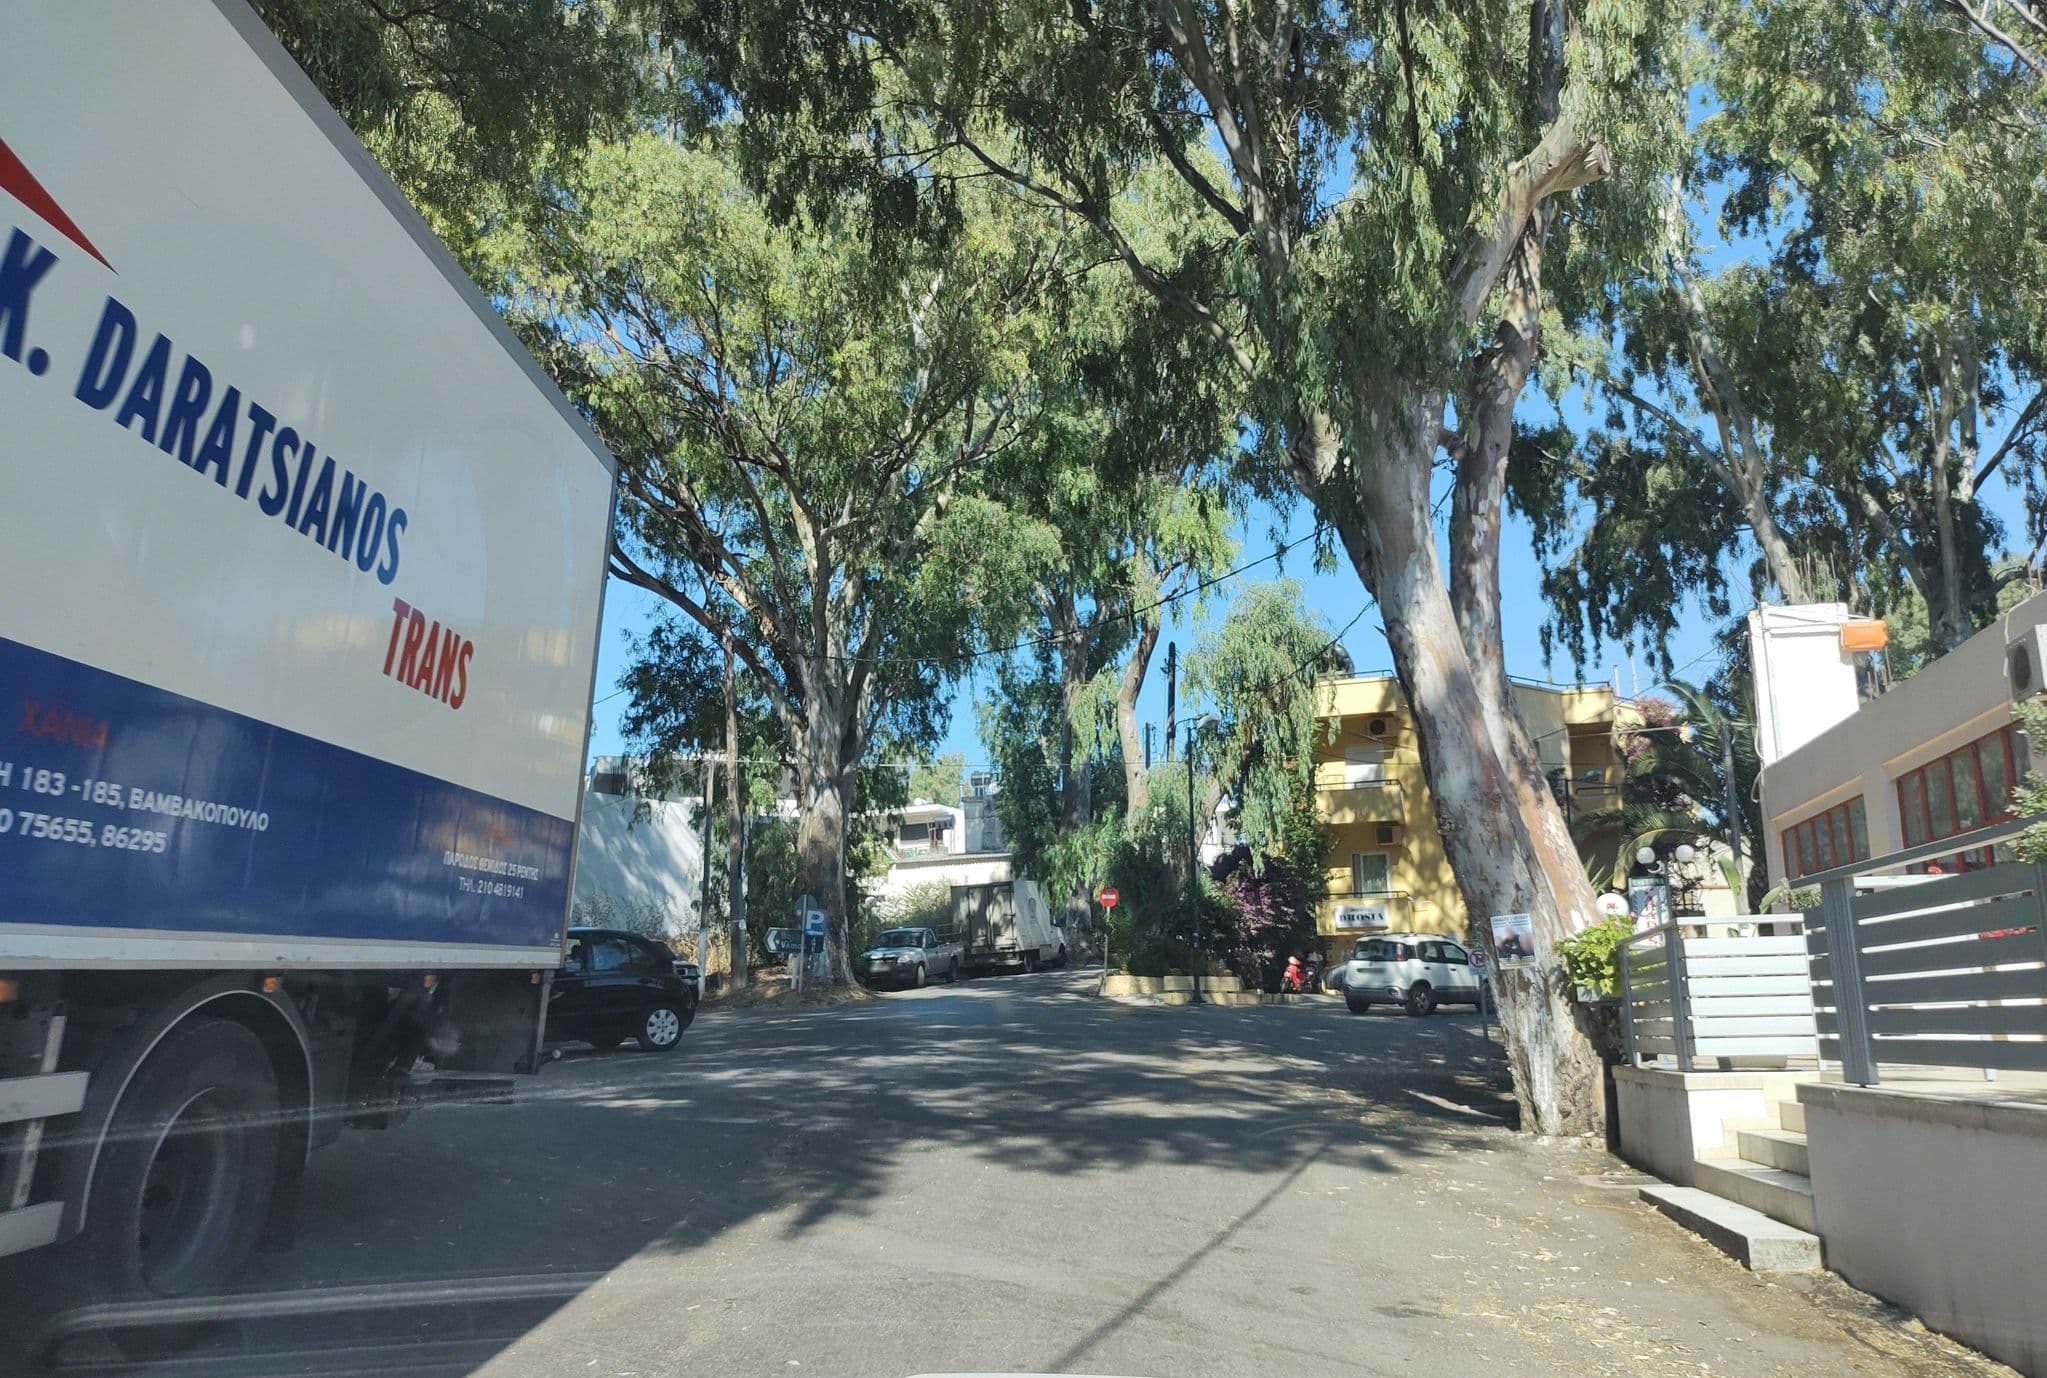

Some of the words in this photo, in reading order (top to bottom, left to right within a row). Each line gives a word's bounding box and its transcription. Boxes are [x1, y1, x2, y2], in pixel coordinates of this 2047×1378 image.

[0, 226, 60, 377] K.
[73, 295, 409, 586] DARATSIANOS
[383, 597, 474, 710] TRANS
[22, 767, 66, 796] 183
[18, 811, 97, 848] 75655,
[101, 825, 168, 854] 86295
[477, 880, 493, 895] 210
[806, 910, 824, 930] P
